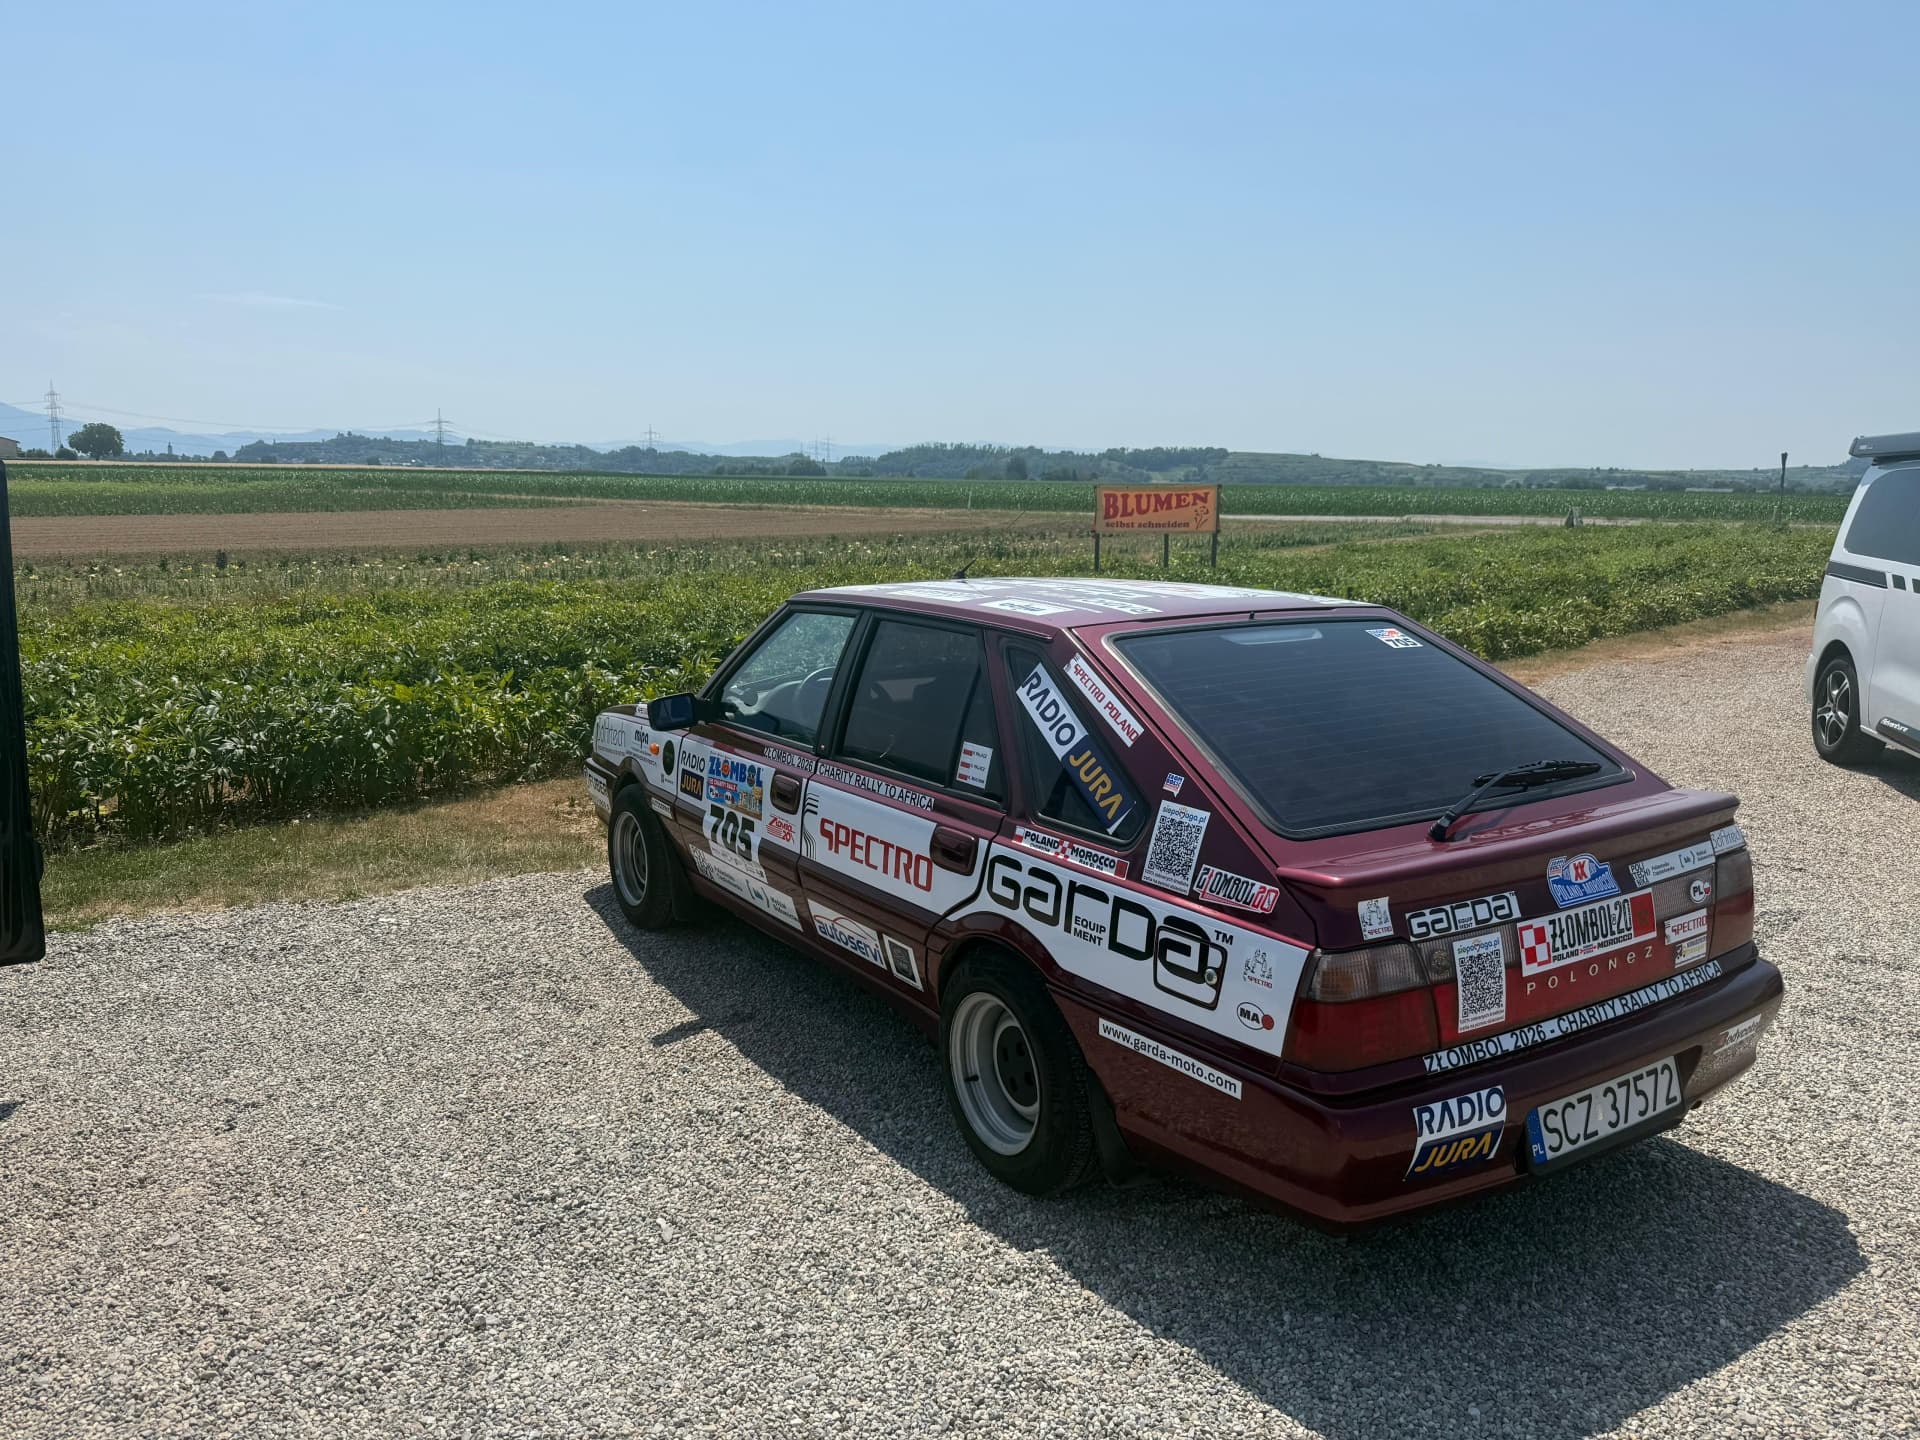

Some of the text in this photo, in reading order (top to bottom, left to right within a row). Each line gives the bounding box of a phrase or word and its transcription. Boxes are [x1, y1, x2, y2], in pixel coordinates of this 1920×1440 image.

[1103, 491, 1210, 520] BLUMEN
[1105, 520, 1190, 529] selbst schneiden
[1384, 637, 1419, 647] 705
[1022, 671, 1076, 746] RADIO
[1073, 664, 1140, 742] SPECTRO POLAND
[681, 750, 706, 773] RADIO
[681, 773, 701, 796] JURA
[797, 757, 813, 773] 2026
[818, 763, 854, 784] CHARITY
[854, 774, 882, 793] RALLY
[884, 784, 897, 798] TO
[897, 789, 934, 812] AFRICA
[1069, 750, 1123, 820] JURA
[710, 803, 754, 862] 705
[820, 817, 933, 893] SPECTRO
[1024, 830, 1116, 869] POLAND MOROCCO
[1573, 861, 1588, 881] XX
[1692, 885, 1704, 897] PL
[1073, 926, 1104, 947] MENT
[1074, 915, 1107, 935] EQUIP
[1214, 929, 1234, 946] TM
[1367, 926, 1393, 935] SPECTRO
[1671, 916, 1707, 936] SPECTRO
[1552, 933, 1633, 963] POLAND MOROCCO
[1247, 974, 1273, 989] SPECTRO
[1239, 1007, 1260, 1024] MA
[1425, 1042, 1510, 1073] ZŁOMBOL
[1511, 1025, 1547, 1050] 2026
[1557, 999, 1616, 1036] CHARITY
[1621, 986, 1661, 1015] RALLY
[1664, 980, 1681, 1000] TO
[1680, 962, 1722, 990] AFRICA
[1102, 1023, 1237, 1094] www.garda-moto.com
[1417, 1087, 1505, 1138] RADIO
[1543, 1063, 1678, 1154] SCZ 37572
[1414, 1131, 1493, 1173] JURA
[1532, 1142, 1545, 1157] PL
